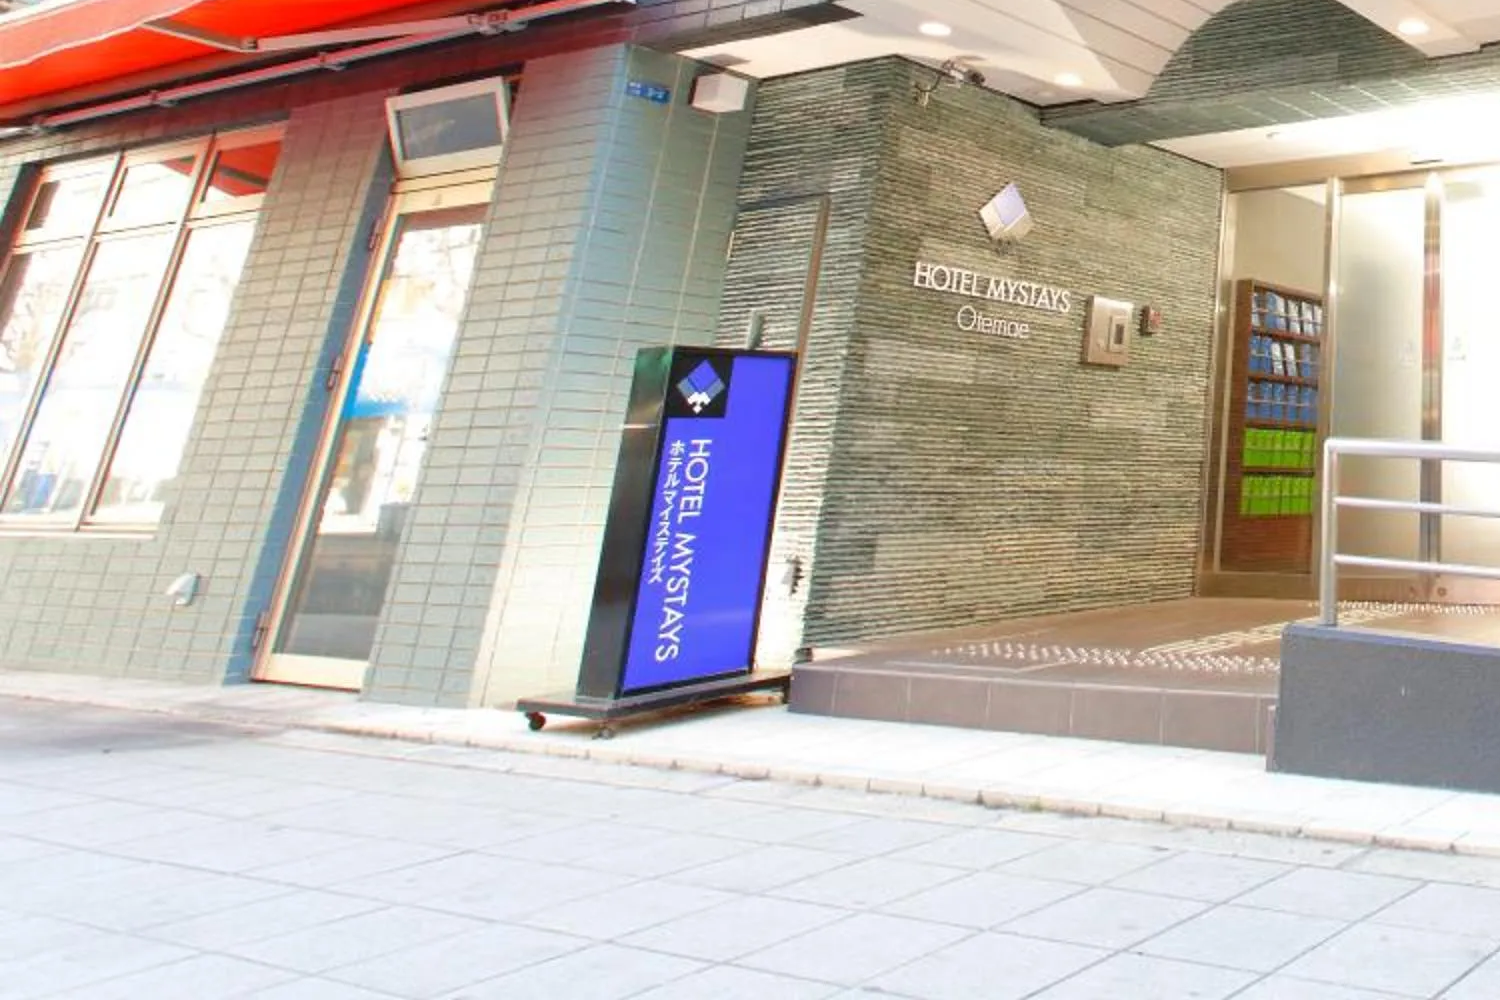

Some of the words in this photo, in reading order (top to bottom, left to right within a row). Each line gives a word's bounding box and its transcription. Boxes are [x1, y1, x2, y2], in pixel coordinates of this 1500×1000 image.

[913, 261, 983, 297] HOTEL
[986, 277, 1071, 313] MYSTAYS
[957, 305, 1029, 338] Otemae
[648, 439, 685, 584] ホテルマイステイズ
[676, 438, 713, 524] HOTEL
[655, 533, 697, 662] MYSTAYS
